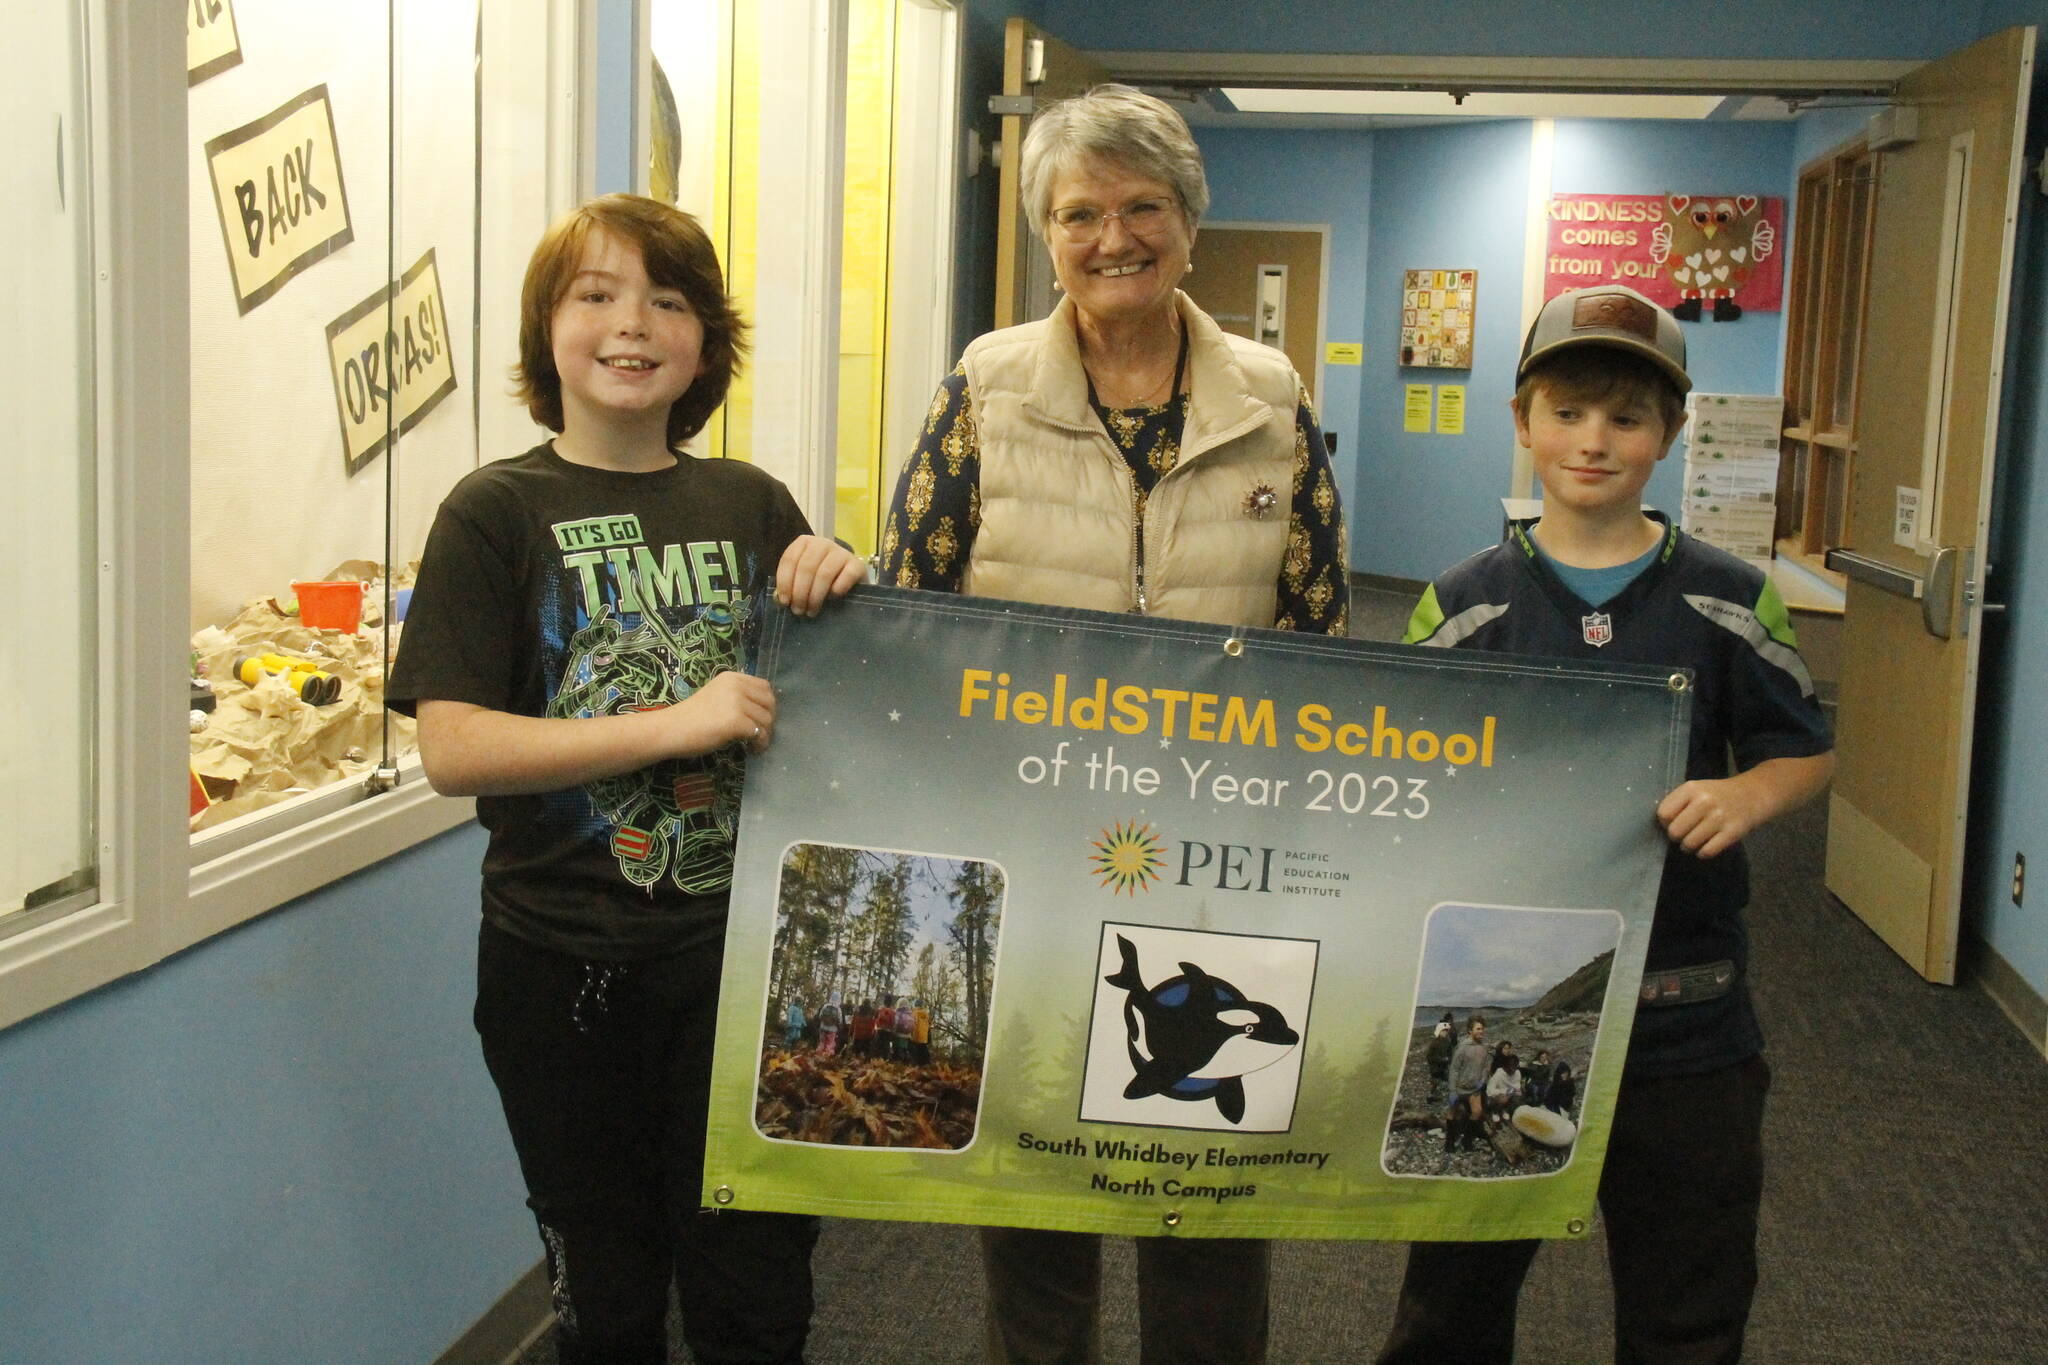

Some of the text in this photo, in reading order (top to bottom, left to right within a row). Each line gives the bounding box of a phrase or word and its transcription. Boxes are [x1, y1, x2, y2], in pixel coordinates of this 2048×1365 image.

[235, 138, 326, 258] BACK
[1545, 200, 1663, 222] KINDNESS
[1561, 228, 1638, 246] comes
[1550, 253, 1662, 280] from your
[343, 294, 441, 425] ORCAS!
[561, 520, 639, 547] IT'S GO
[563, 541, 742, 619] TIME!
[1588, 626, 1608, 641] NFL
[959, 668, 1496, 768] FieldSTEM School
[1017, 741, 1430, 820] of the Year 2023
[1174, 840, 1276, 893] PEI
[1285, 850, 1329, 862] PACIFIC
[1283, 867, 1350, 881] EDUCATION
[1282, 884, 1341, 898] INSTITUTE
[1017, 1132, 1331, 1171] South Whidbey Elementary
[1090, 1173, 1256, 1204] North Campus
